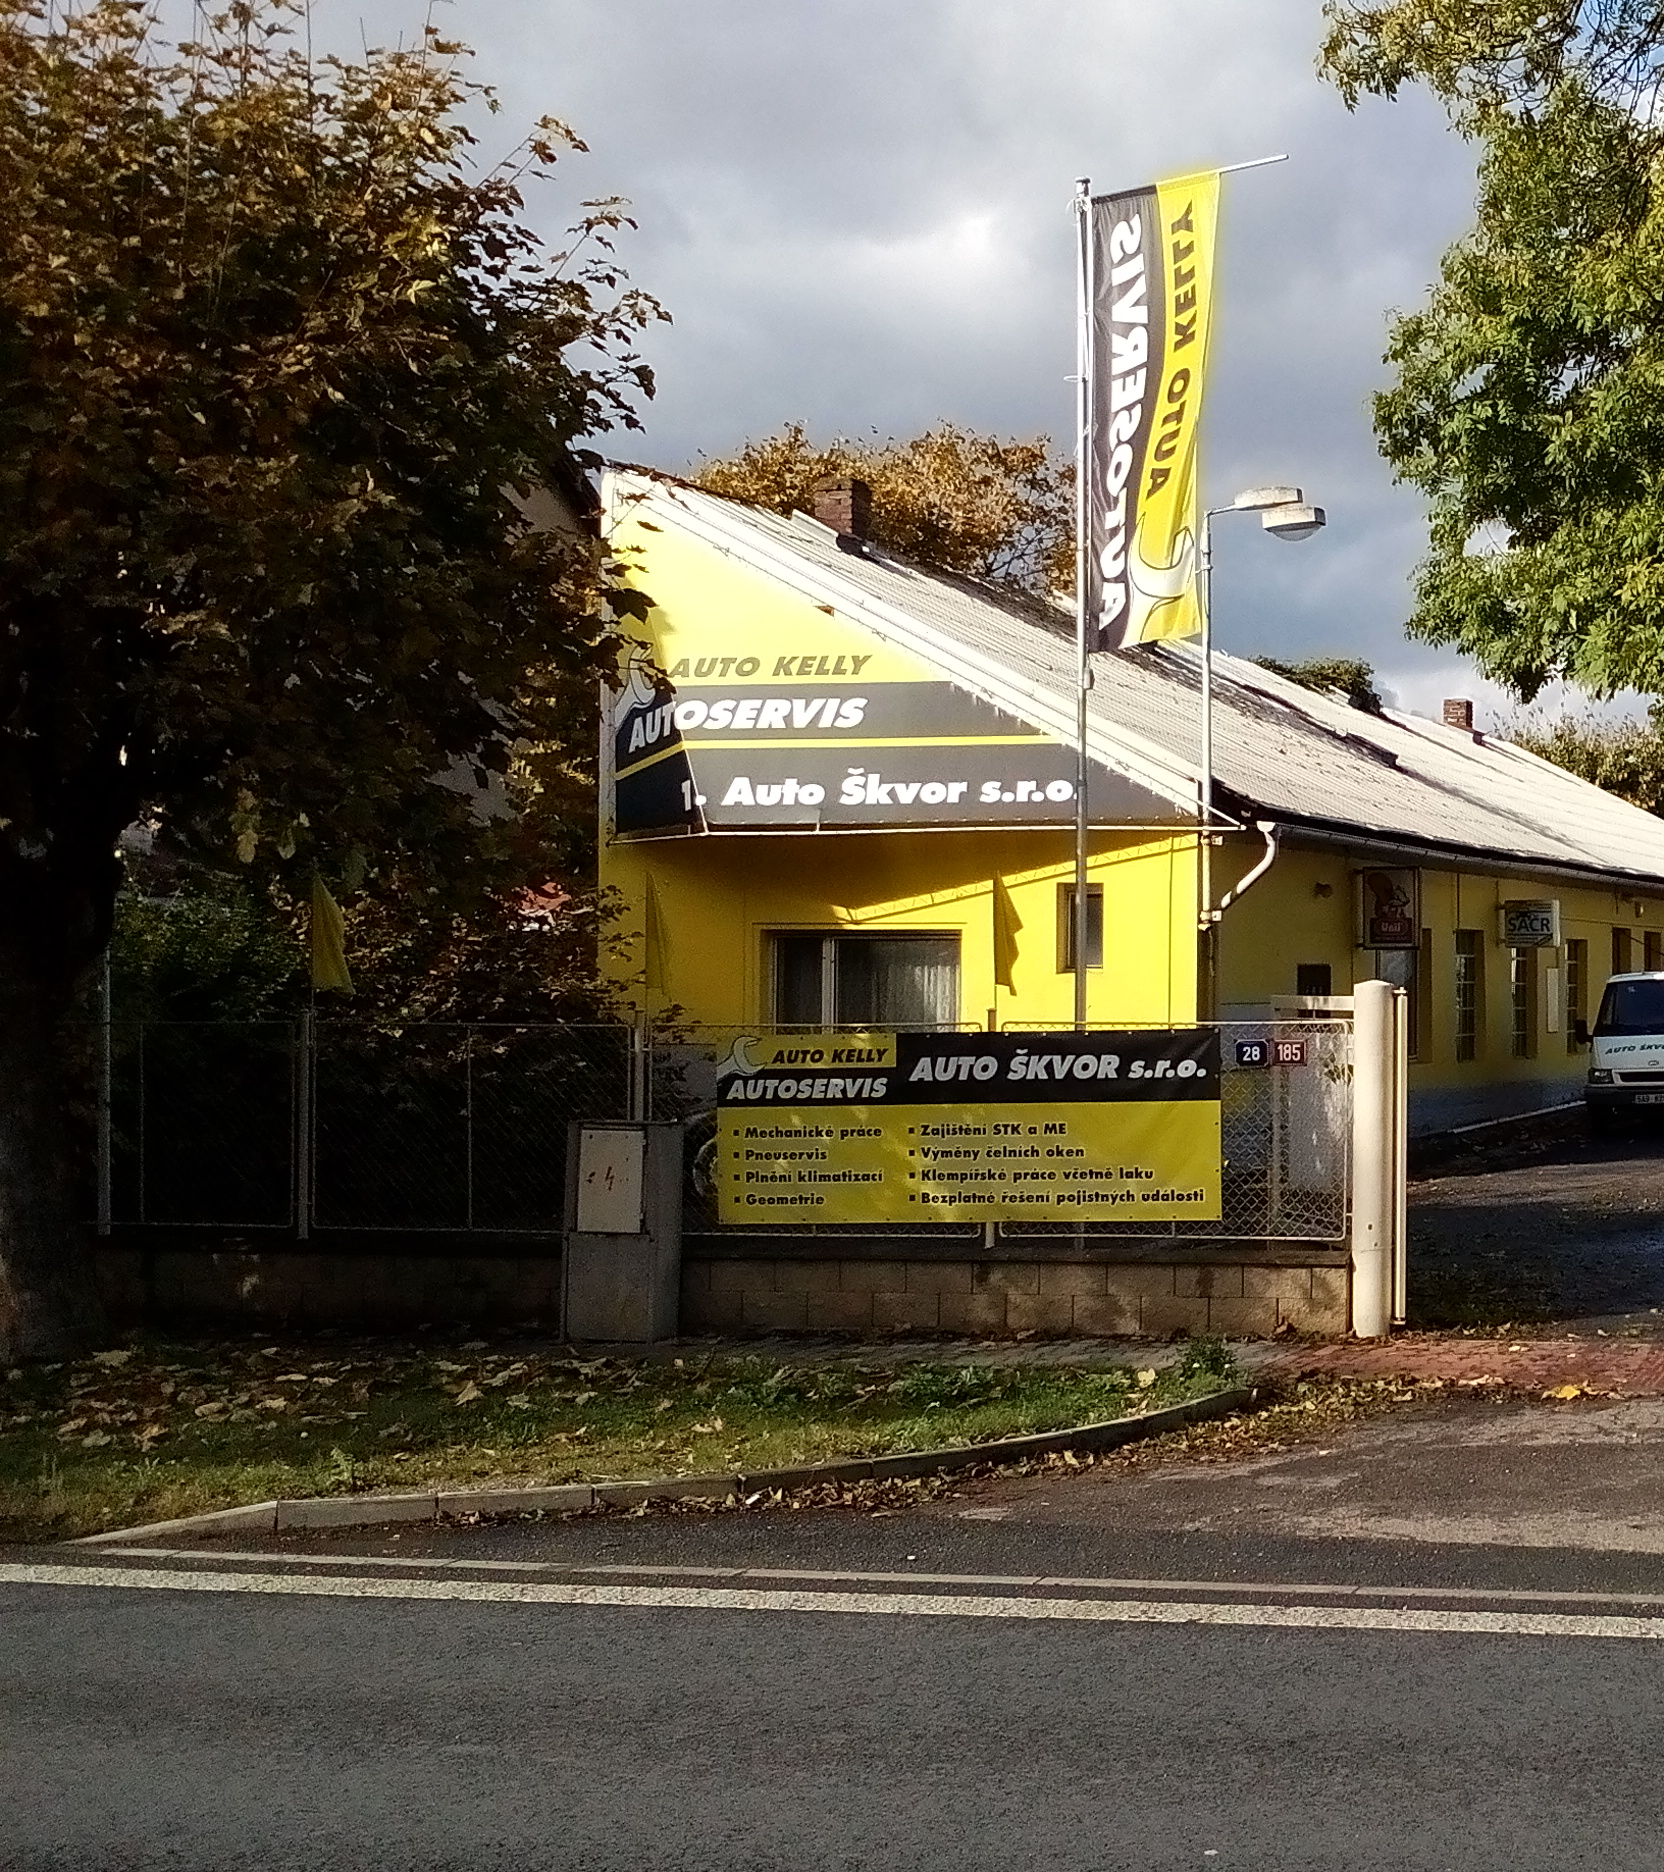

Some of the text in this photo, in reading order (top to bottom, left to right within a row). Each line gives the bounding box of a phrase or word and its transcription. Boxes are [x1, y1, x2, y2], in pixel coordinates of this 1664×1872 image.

[668, 654, 873, 678] AUTO KELLY
[628, 697, 869, 754] AUTOSERVIS
[721, 775, 826, 806] Auto
[839, 767, 968, 806] Škvor
[979, 779, 1077, 804] s.r.o
[1507, 915, 1551, 933] SAČR
[771, 1048, 889, 1065] AUTO KELLY
[1242, 1046, 1260, 1061] 28
[1277, 1044, 1301, 1061] 185
[1605, 1045, 1637, 1054] AUTO
[908, 1048, 1207, 1082] AUTO ŠKVOR s.r.o.
[725, 1078, 888, 1100] AUTOSERVIS
[744, 1125, 882, 1141] Mechanické práce
[920, 1123, 1067, 1139] Zajištění STK a ME
[745, 1147, 827, 1161] Pneuservis
[921, 1145, 1085, 1162] Výměny čelních oken
[745, 1169, 883, 1183] Plnění klimatizací
[921, 1167, 1154, 1185] Klempířské práce včetně laku
[745, 1193, 825, 1205] Geometrie
[921, 1188, 1205, 1206] Bezplatné řešení pojistných události
